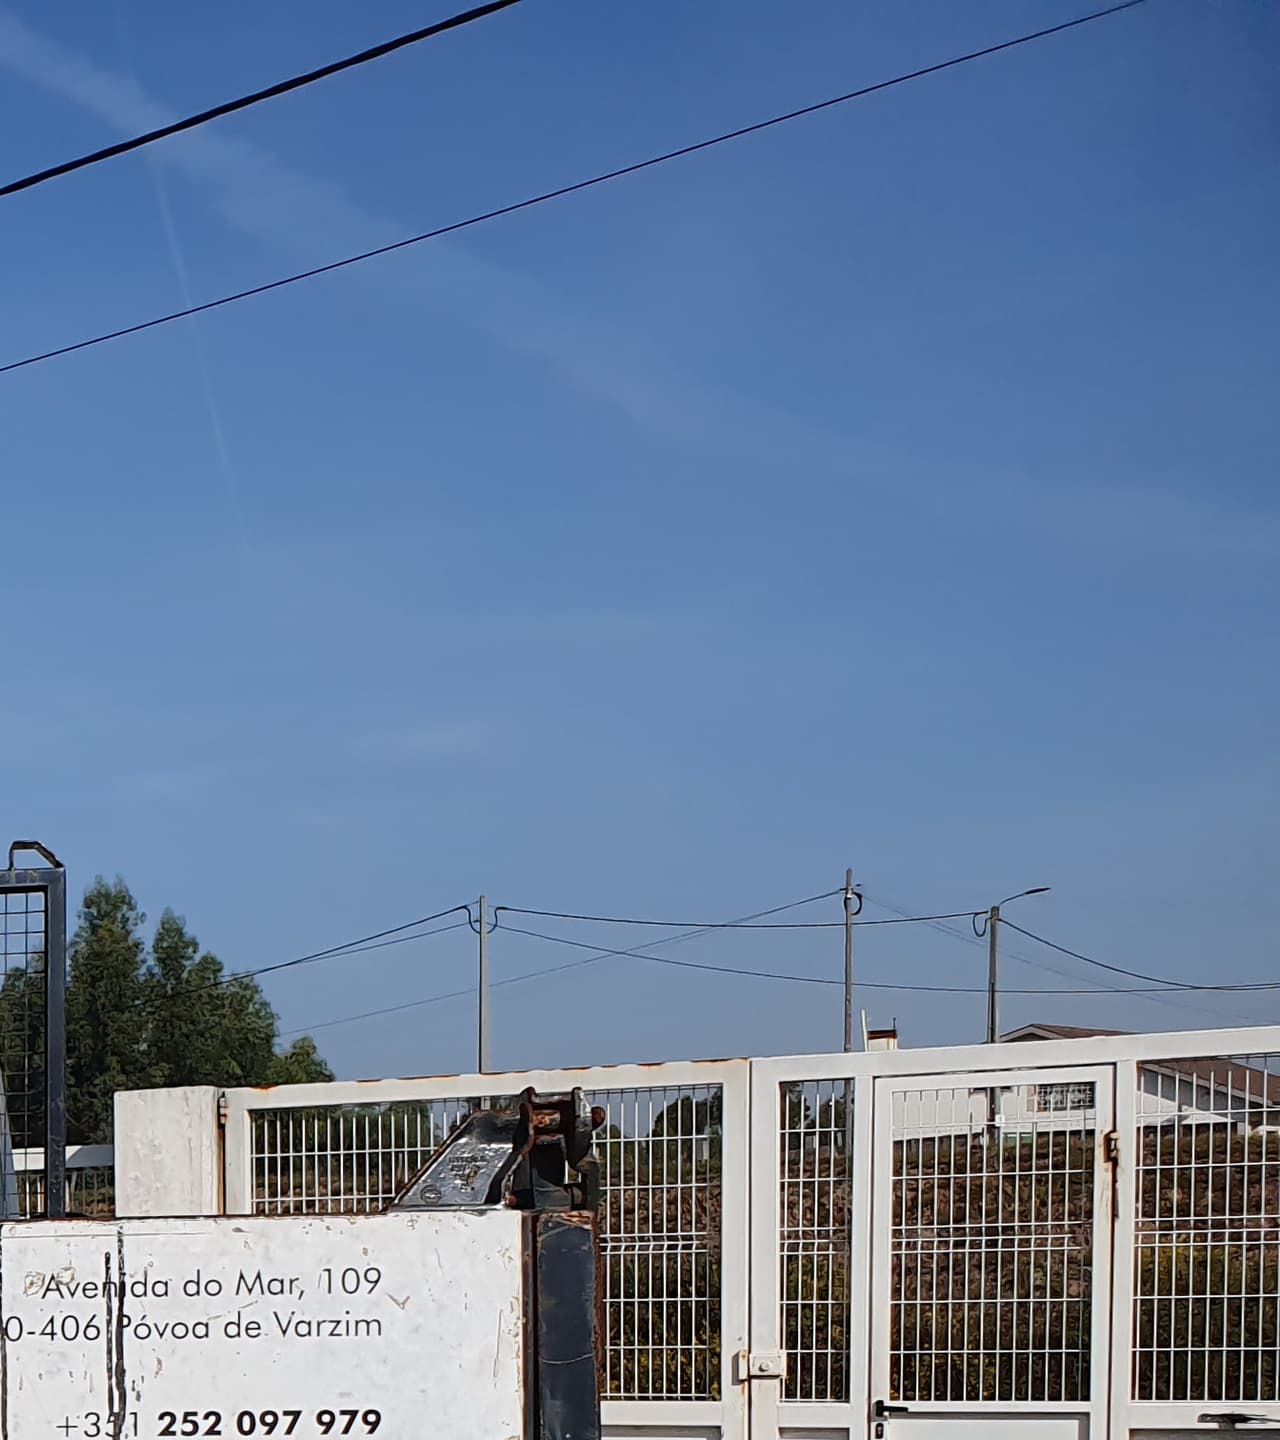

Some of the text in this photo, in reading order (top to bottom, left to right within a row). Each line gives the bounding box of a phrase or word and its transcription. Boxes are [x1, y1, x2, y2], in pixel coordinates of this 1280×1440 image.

[41, 1266, 382, 1301] Avenida do Mar, 109
[120, 1313, 210, 1340] Póvoa
[224, 1310, 262, 1339] de
[272, 1310, 383, 1338] Varzim
[156, 1410, 223, 1437] 252
[236, 1410, 303, 1436] 097
[315, 1409, 382, 1435] 979
